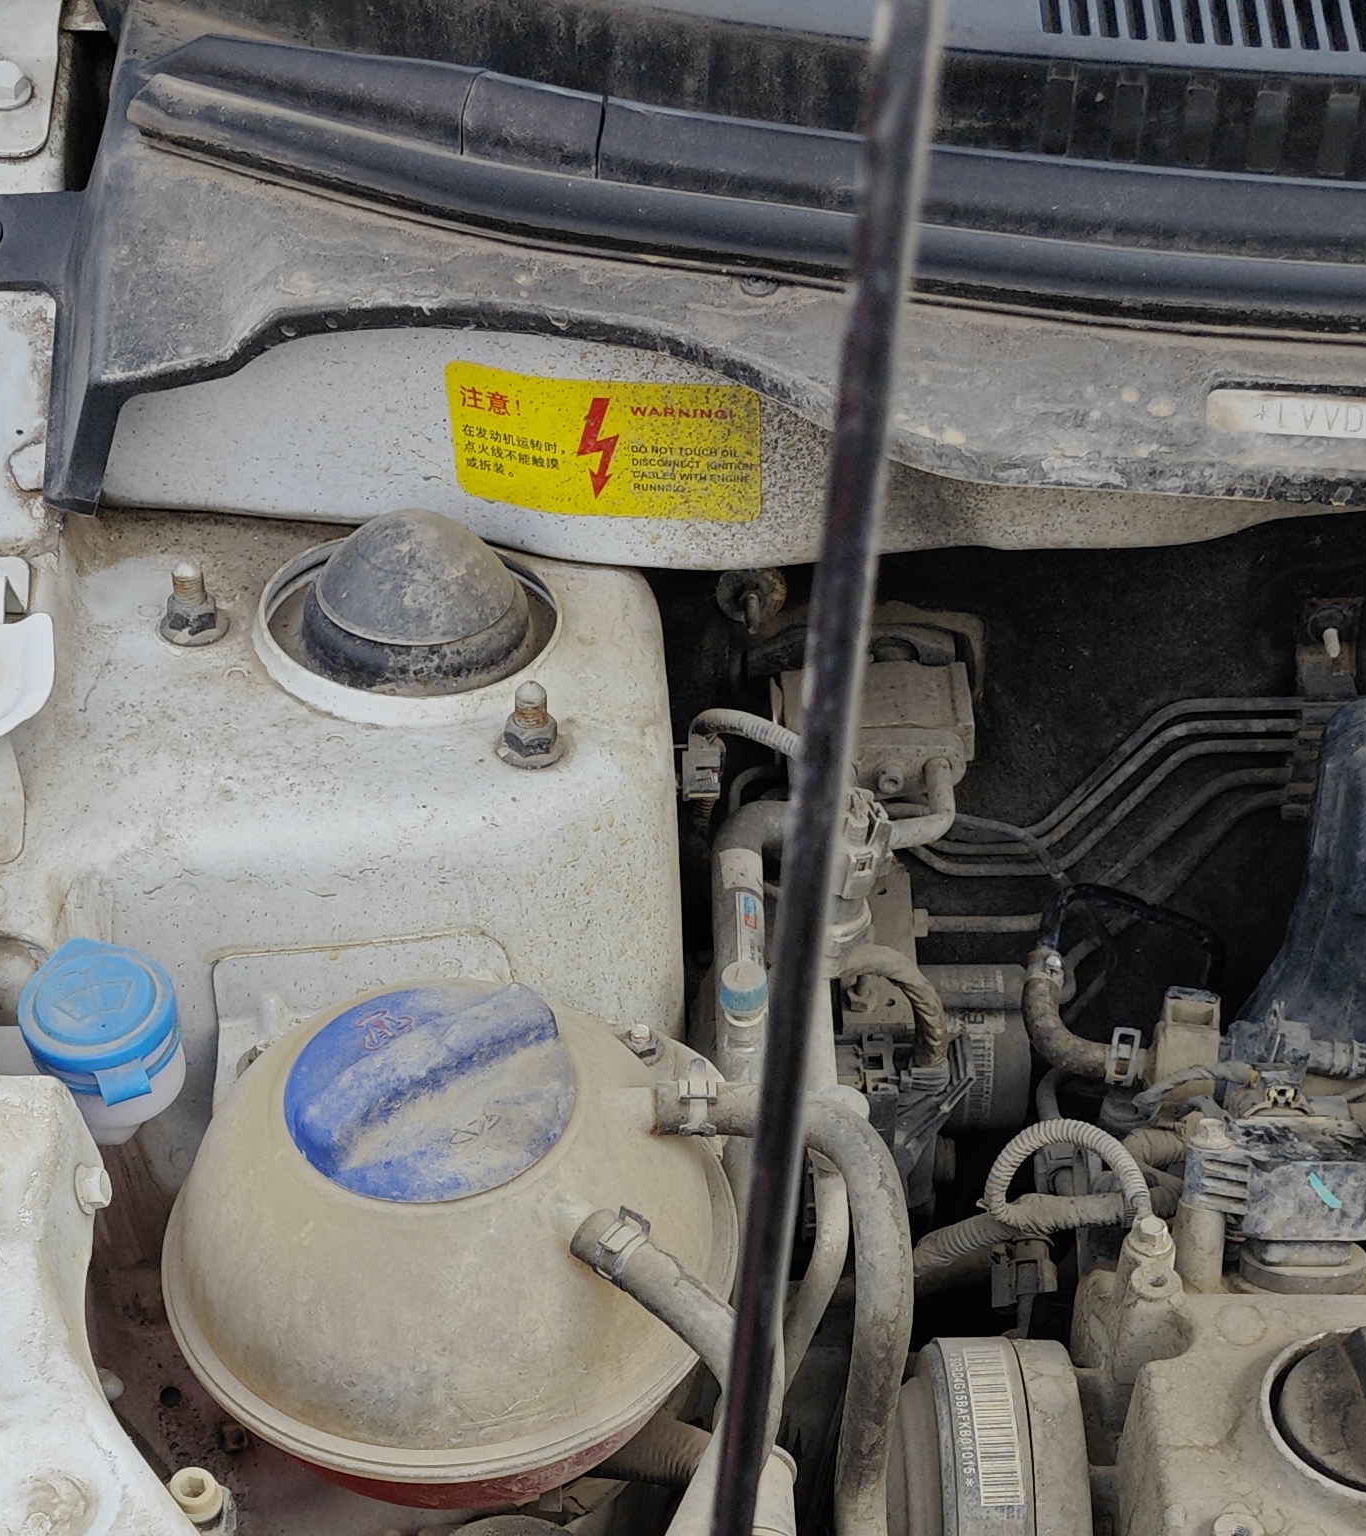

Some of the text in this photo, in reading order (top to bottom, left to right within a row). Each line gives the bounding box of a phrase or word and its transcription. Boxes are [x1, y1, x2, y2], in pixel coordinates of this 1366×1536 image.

[463, 440, 560, 471] 点火线不能触摸
[630, 445, 648, 454] DO
[651, 445, 674, 455] NOT
[679, 446, 718, 457] TOUCH
[631, 457, 753, 472] DISCONNECT IGNITION
[632, 470, 677, 481] CABLES
[679, 472, 707, 483] WITH
